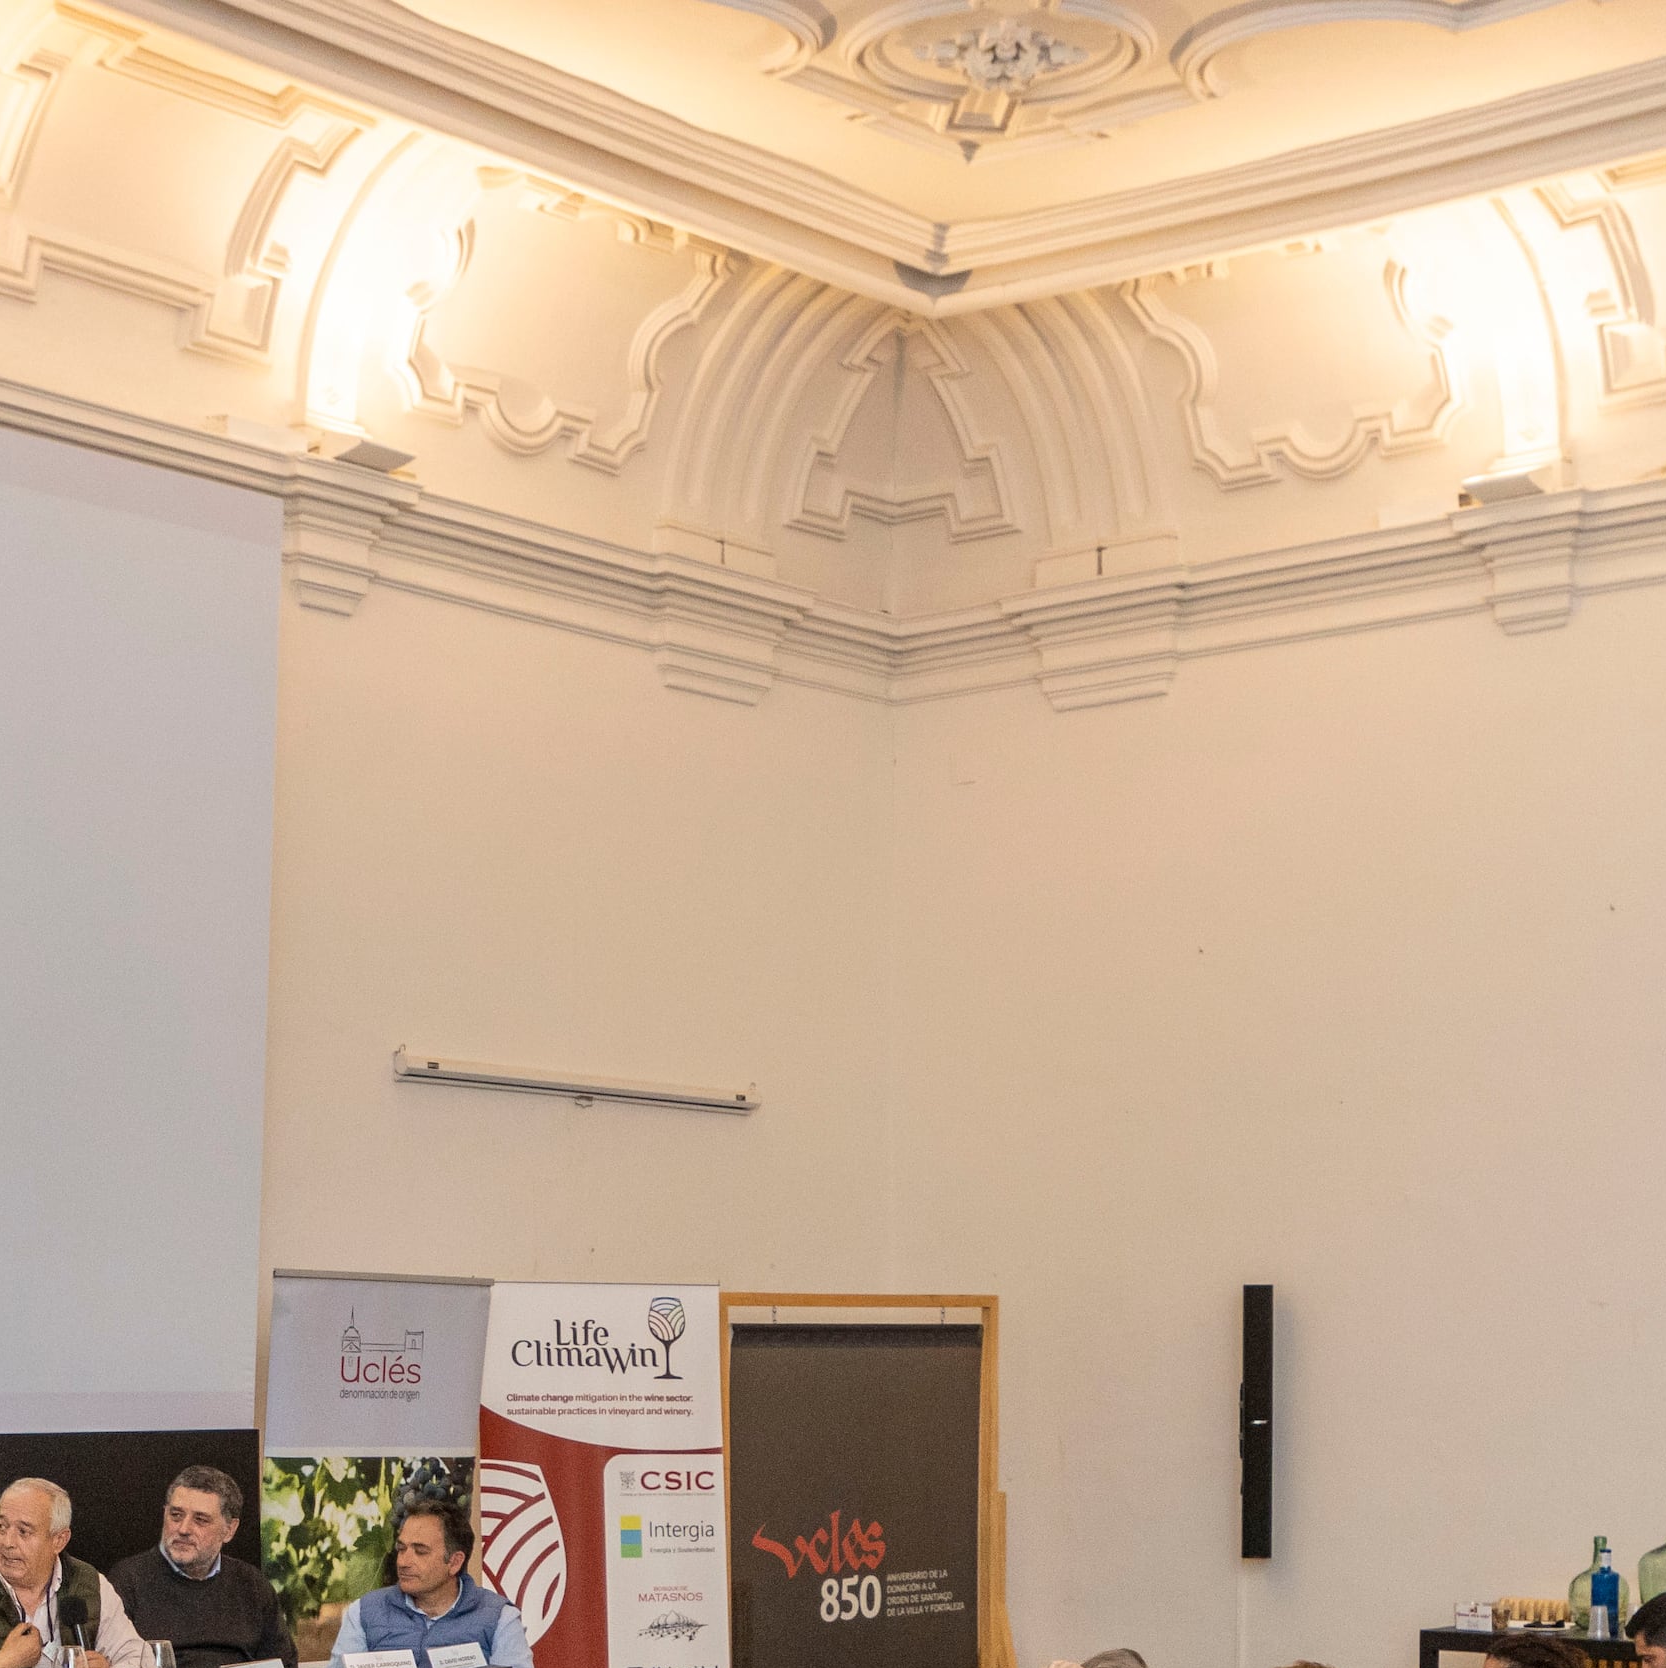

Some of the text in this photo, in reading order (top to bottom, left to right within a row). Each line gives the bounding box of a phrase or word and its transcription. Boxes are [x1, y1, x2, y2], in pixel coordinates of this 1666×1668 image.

[554, 1319, 610, 1347] Life
[341, 1355, 421, 1383] Uclés
[506, 1393, 540, 1402] Climate
[541, 1393, 574, 1404] change
[576, 1394, 618, 1404] mitigation
[644, 1394, 664, 1402] wine
[506, 1407, 556, 1415] sustainable
[558, 1407, 597, 1417] practices
[609, 1407, 644, 1417] vineyard
[664, 1408, 693, 1417] winery.
[641, 1471, 715, 1490] CSIC
[649, 1520, 715, 1542] Intergia
[939, 1570, 948, 1578] LA
[928, 1582, 937, 1590] LA
[639, 1592, 702, 1602] MATASNOS
[820, 1574, 882, 1623] 850
[910, 1594, 919, 1603] DE
[887, 1608, 895, 1616] DE
[897, 1607, 905, 1616] LA
